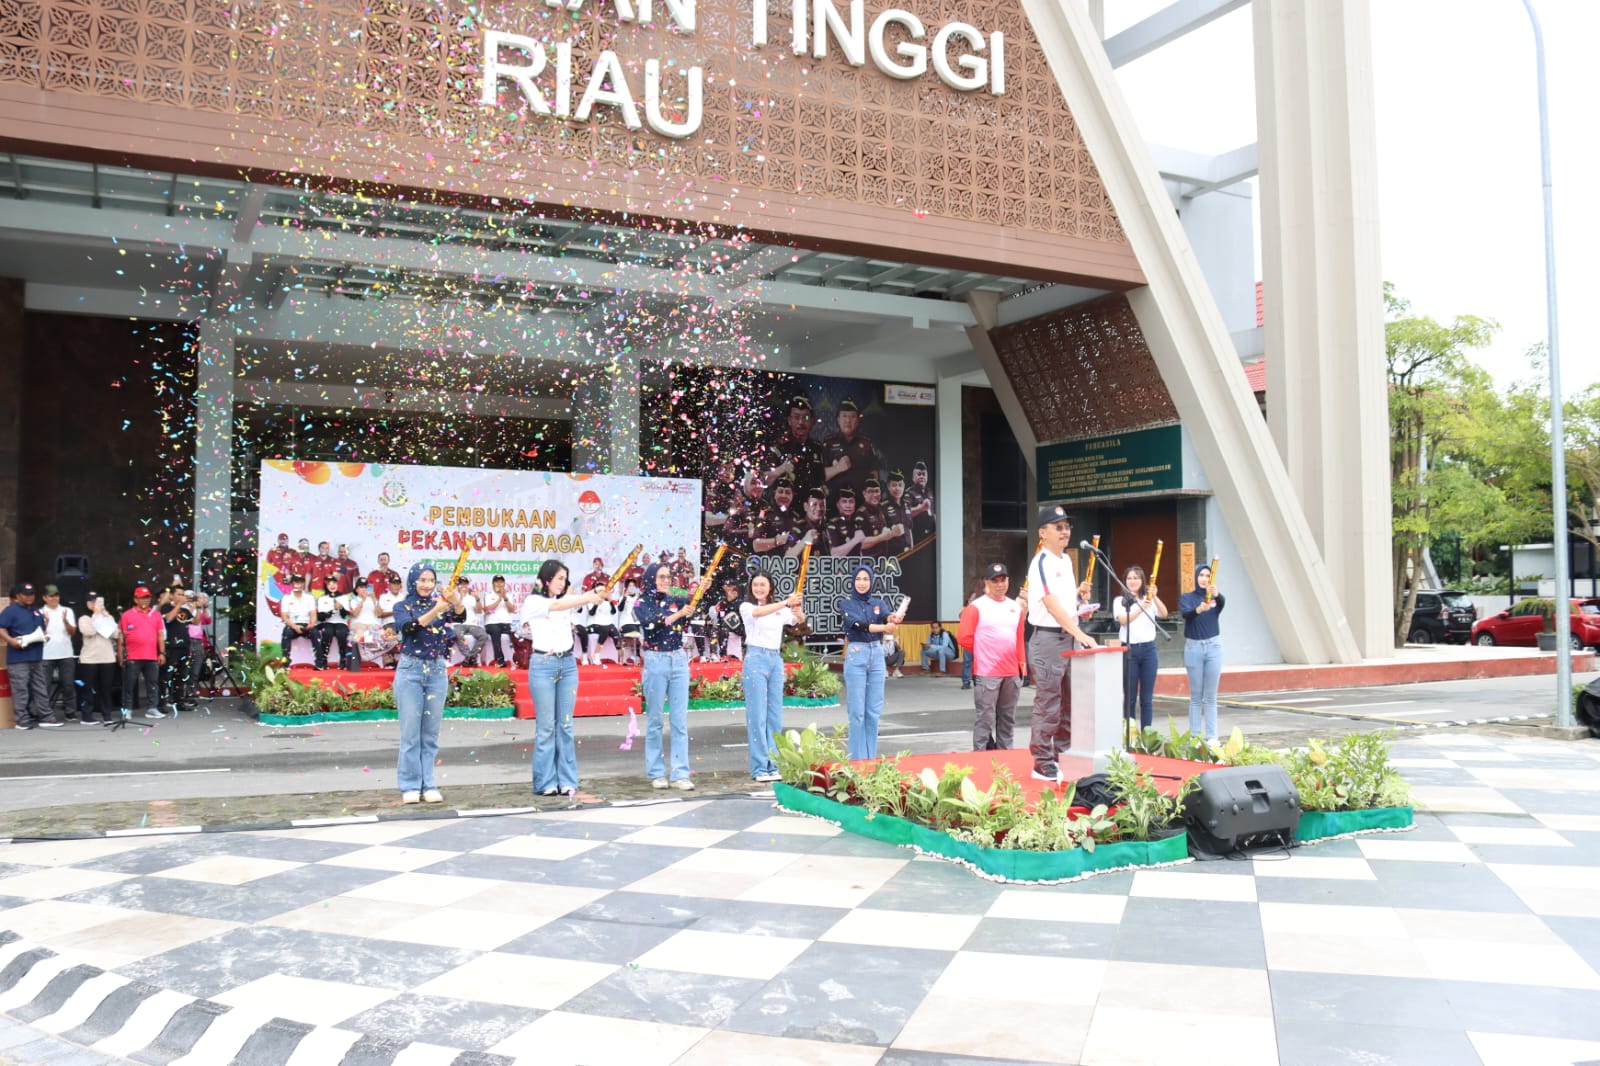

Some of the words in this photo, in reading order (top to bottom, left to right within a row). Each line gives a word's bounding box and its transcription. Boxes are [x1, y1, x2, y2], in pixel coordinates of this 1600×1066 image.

[480, 29, 704, 139] RIAU
[429, 506, 557, 528] PEMBUKAAN
[398, 530, 467, 551] PEKAN
[472, 531, 526, 553] OLAH
[531, 534, 585, 554] RAGA
[432, 561, 492, 572] EJASAAN
[495, 562, 531, 573] TINGGI
[746, 556, 799, 576] SIAP
